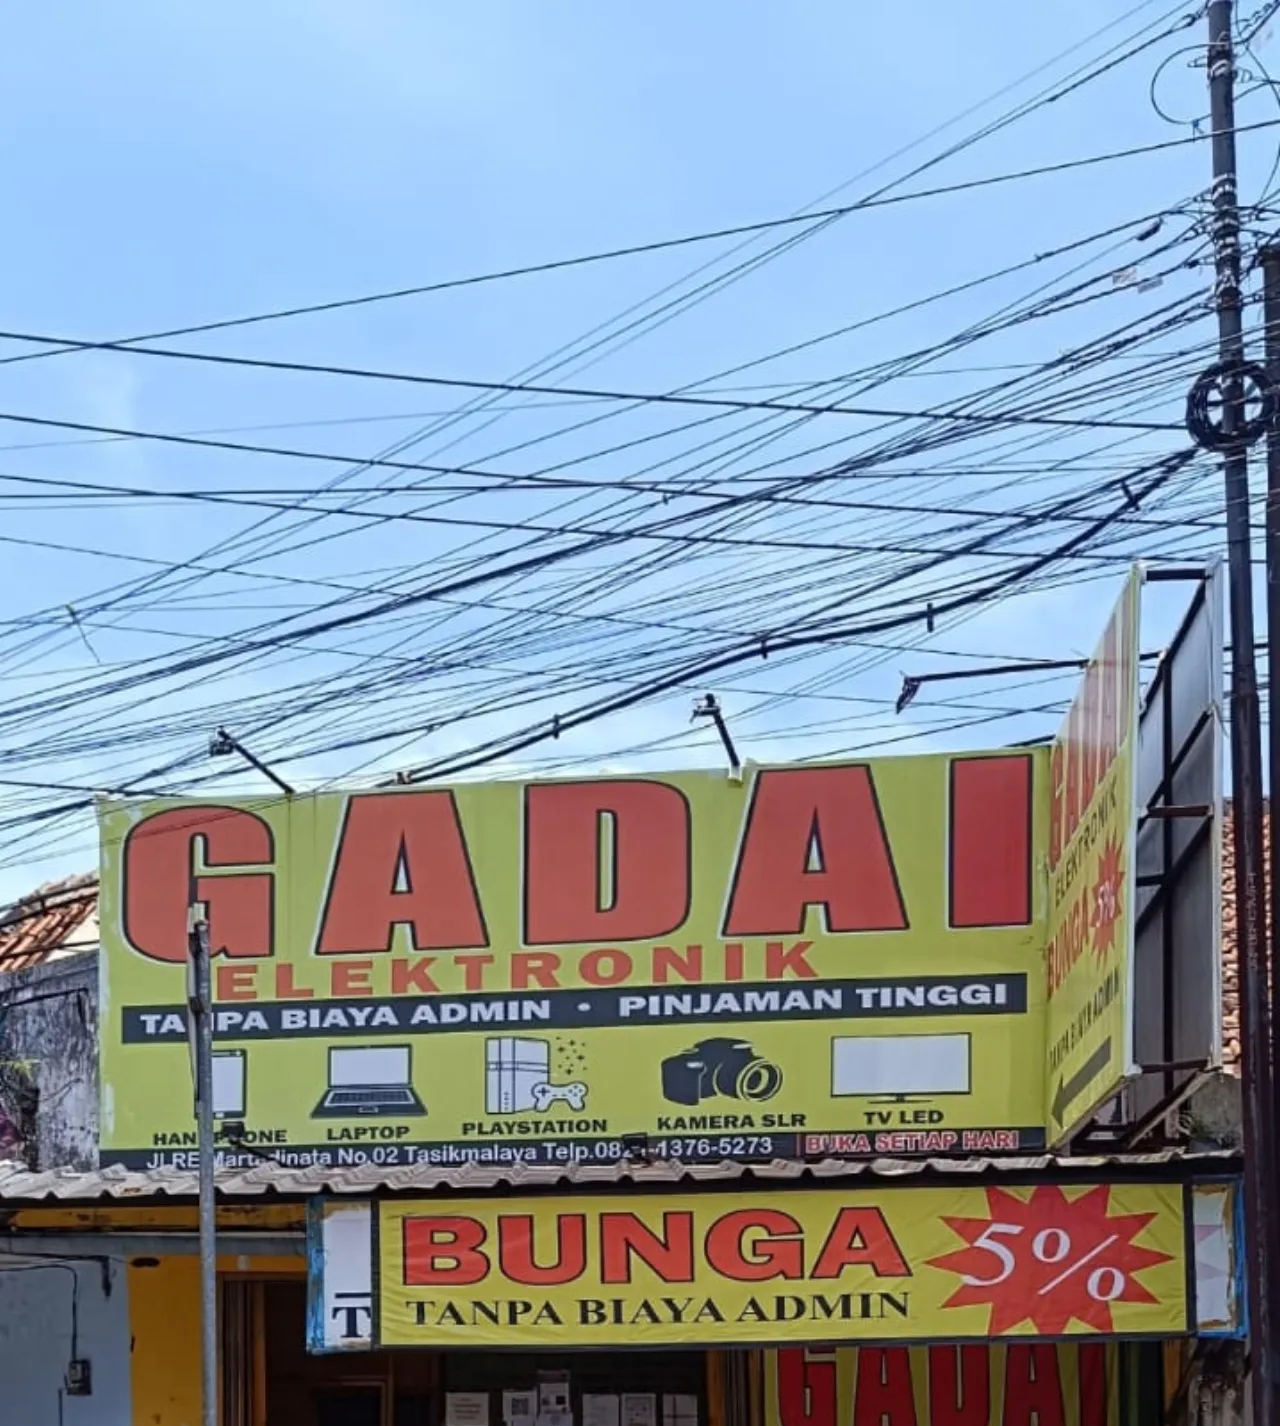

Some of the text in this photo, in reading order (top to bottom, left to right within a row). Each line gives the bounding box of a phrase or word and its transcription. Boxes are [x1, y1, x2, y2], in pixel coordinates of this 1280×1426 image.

[1055, 775, 1117, 907] ELEKTRONIK
[122, 754, 1033, 963] GADAI
[1046, 886, 1089, 1002] BUNGA
[216, 941, 819, 1000] ELEKTRONIK
[141, 982, 1008, 1036] TAPA BIAYA ADMIN PINJAMAN TINGGI
[326, 1126, 410, 1141] LAPTOP
[462, 1118, 608, 1135] PLAYSTATION
[657, 1113, 806, 1131] KAMERA SLR
[865, 1109, 944, 1126] TV LED
[153, 1130, 287, 1147] HANPONE
[404, 1142, 537, 1163] Tasikmalaya
[806, 1129, 1020, 1154] BUKA SETIAP HARI
[402, 1206, 1126, 1301] BUNGA 5%
[331, 1306, 371, 1338] T
[406, 1292, 911, 1326] TANPA BIAYA ADMIN
